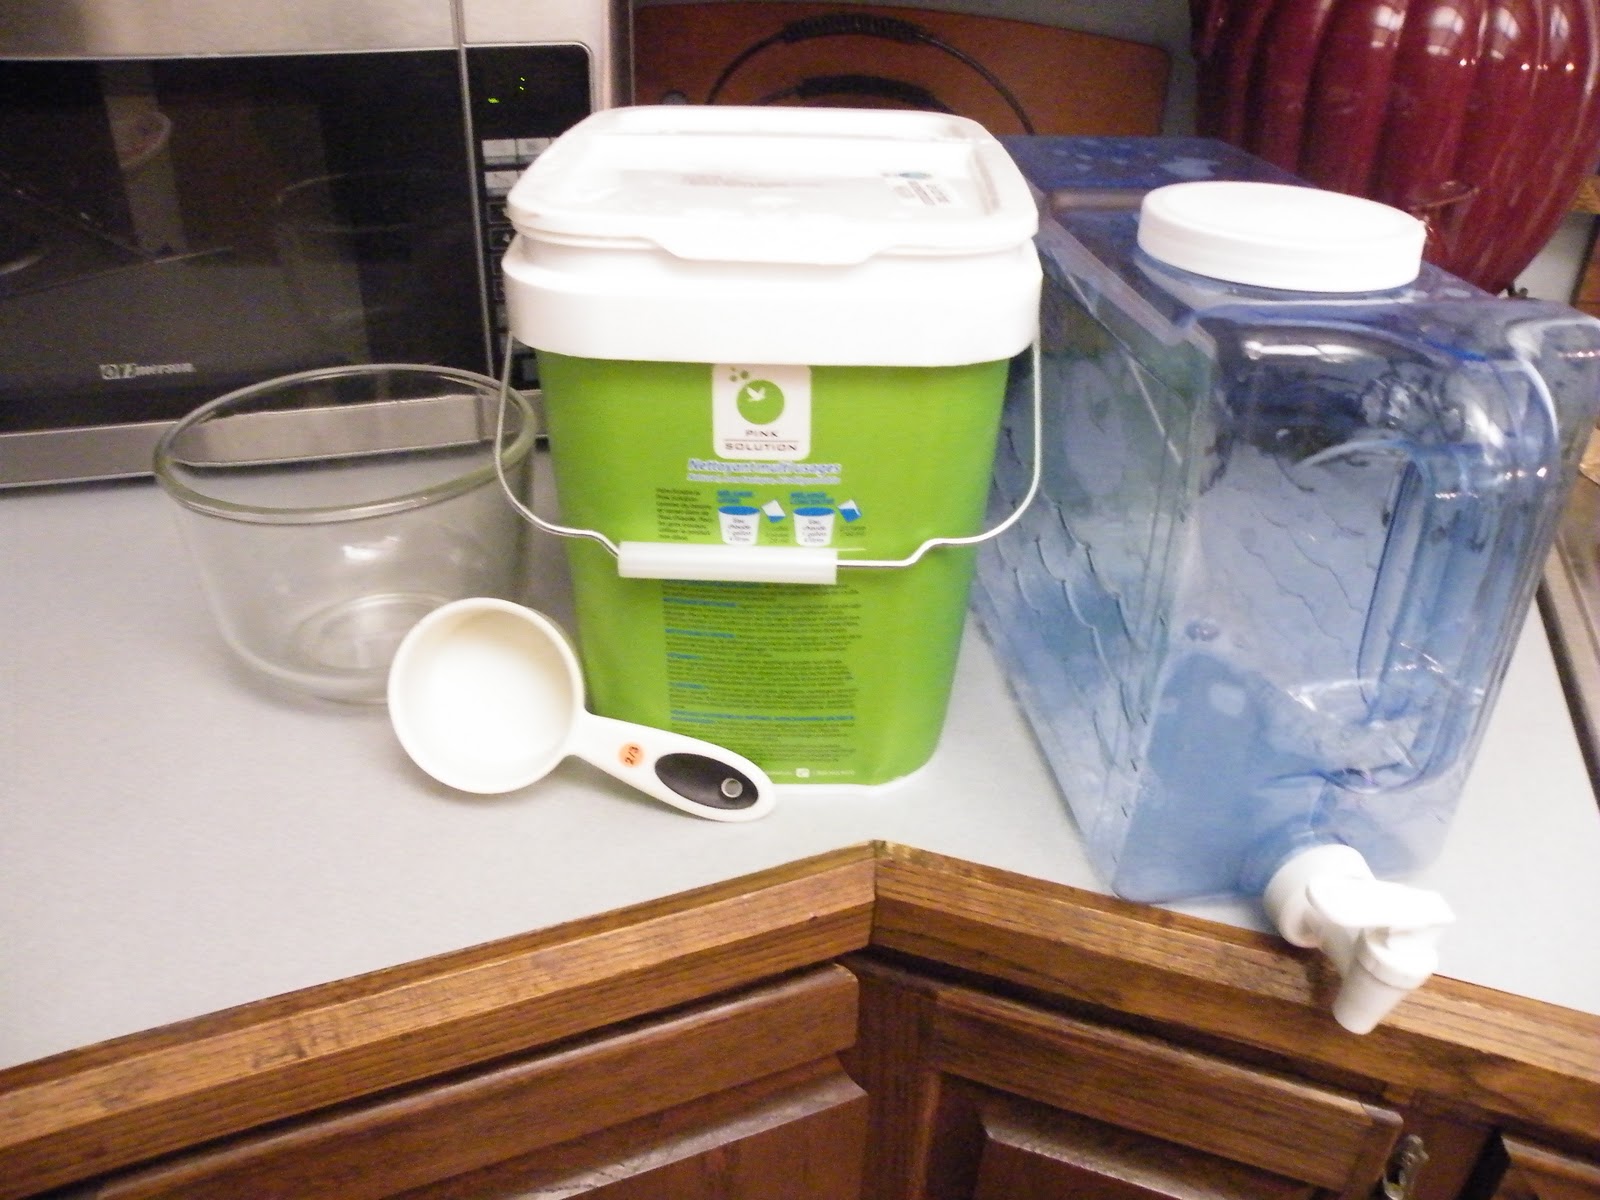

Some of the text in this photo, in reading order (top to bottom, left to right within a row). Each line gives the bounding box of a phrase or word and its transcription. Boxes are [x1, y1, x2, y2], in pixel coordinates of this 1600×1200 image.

[745, 428, 780, 438] PINK
[724, 442, 798, 452] SOLUTION
[623, 745, 640, 766] 2/3
